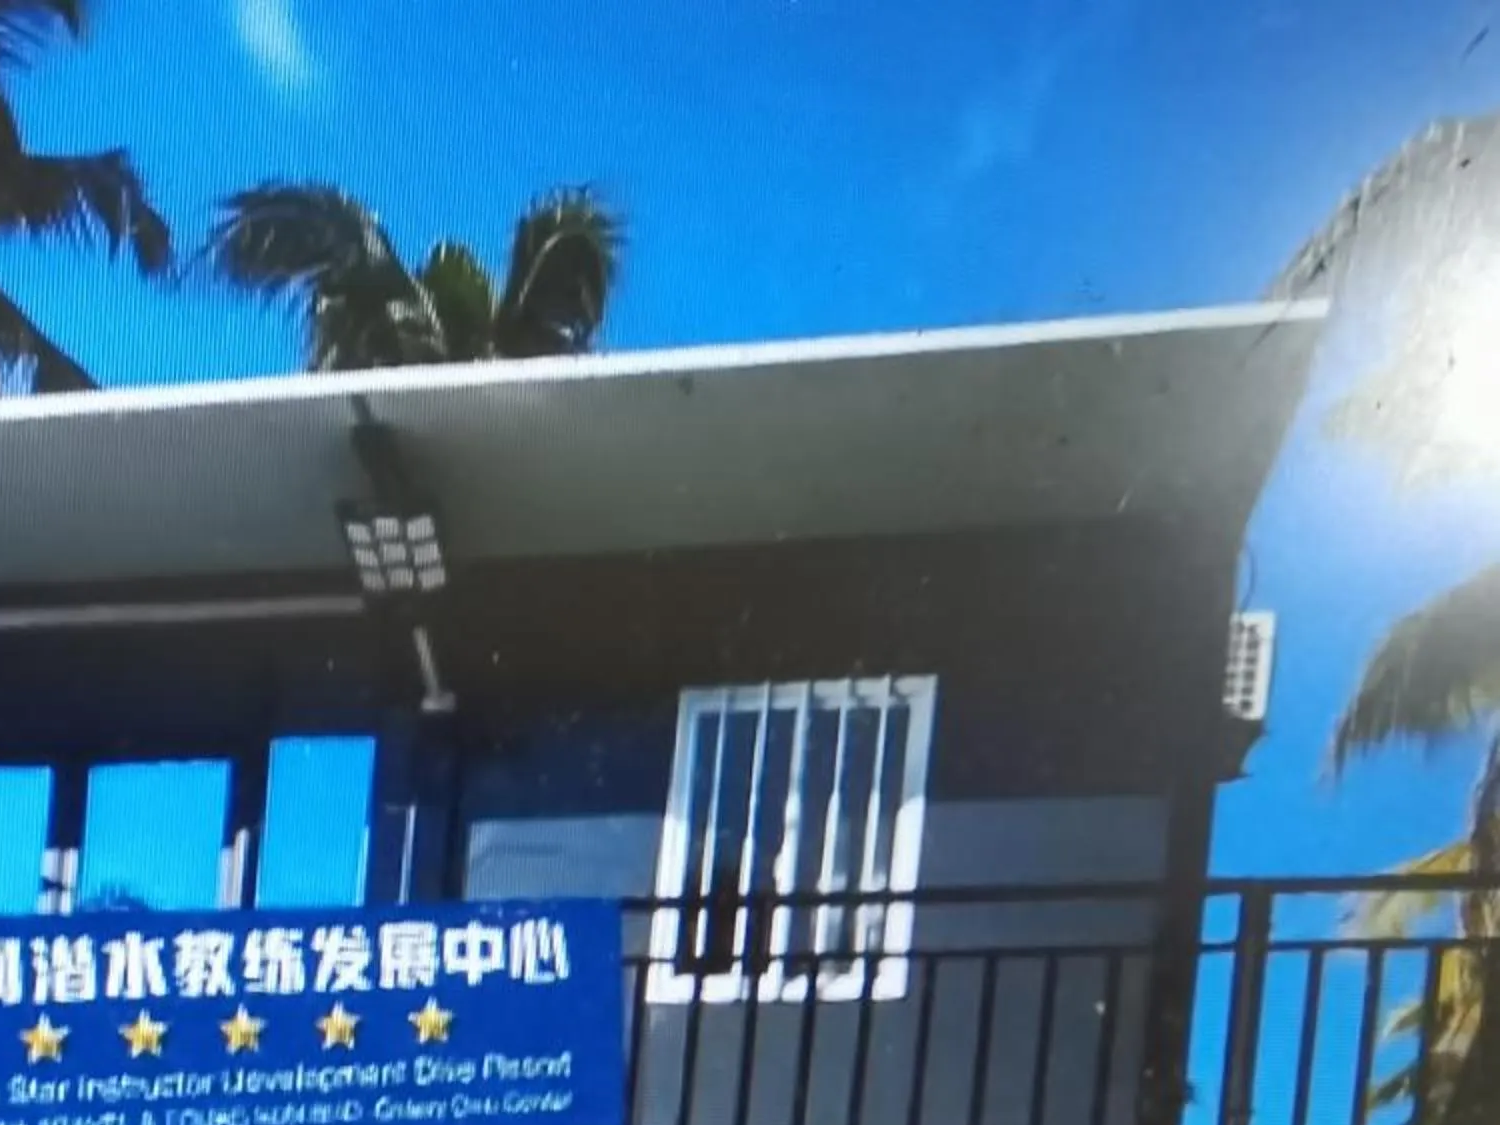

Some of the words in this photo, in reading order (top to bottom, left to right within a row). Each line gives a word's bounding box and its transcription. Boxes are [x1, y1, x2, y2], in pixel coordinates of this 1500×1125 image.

[9, 1074, 70, 1104] Star
[78, 1072, 213, 1102] Instructor
[221, 1061, 406, 1094] Development
[414, 1056, 476, 1086] Dive
[482, 1051, 572, 1079] Resort
